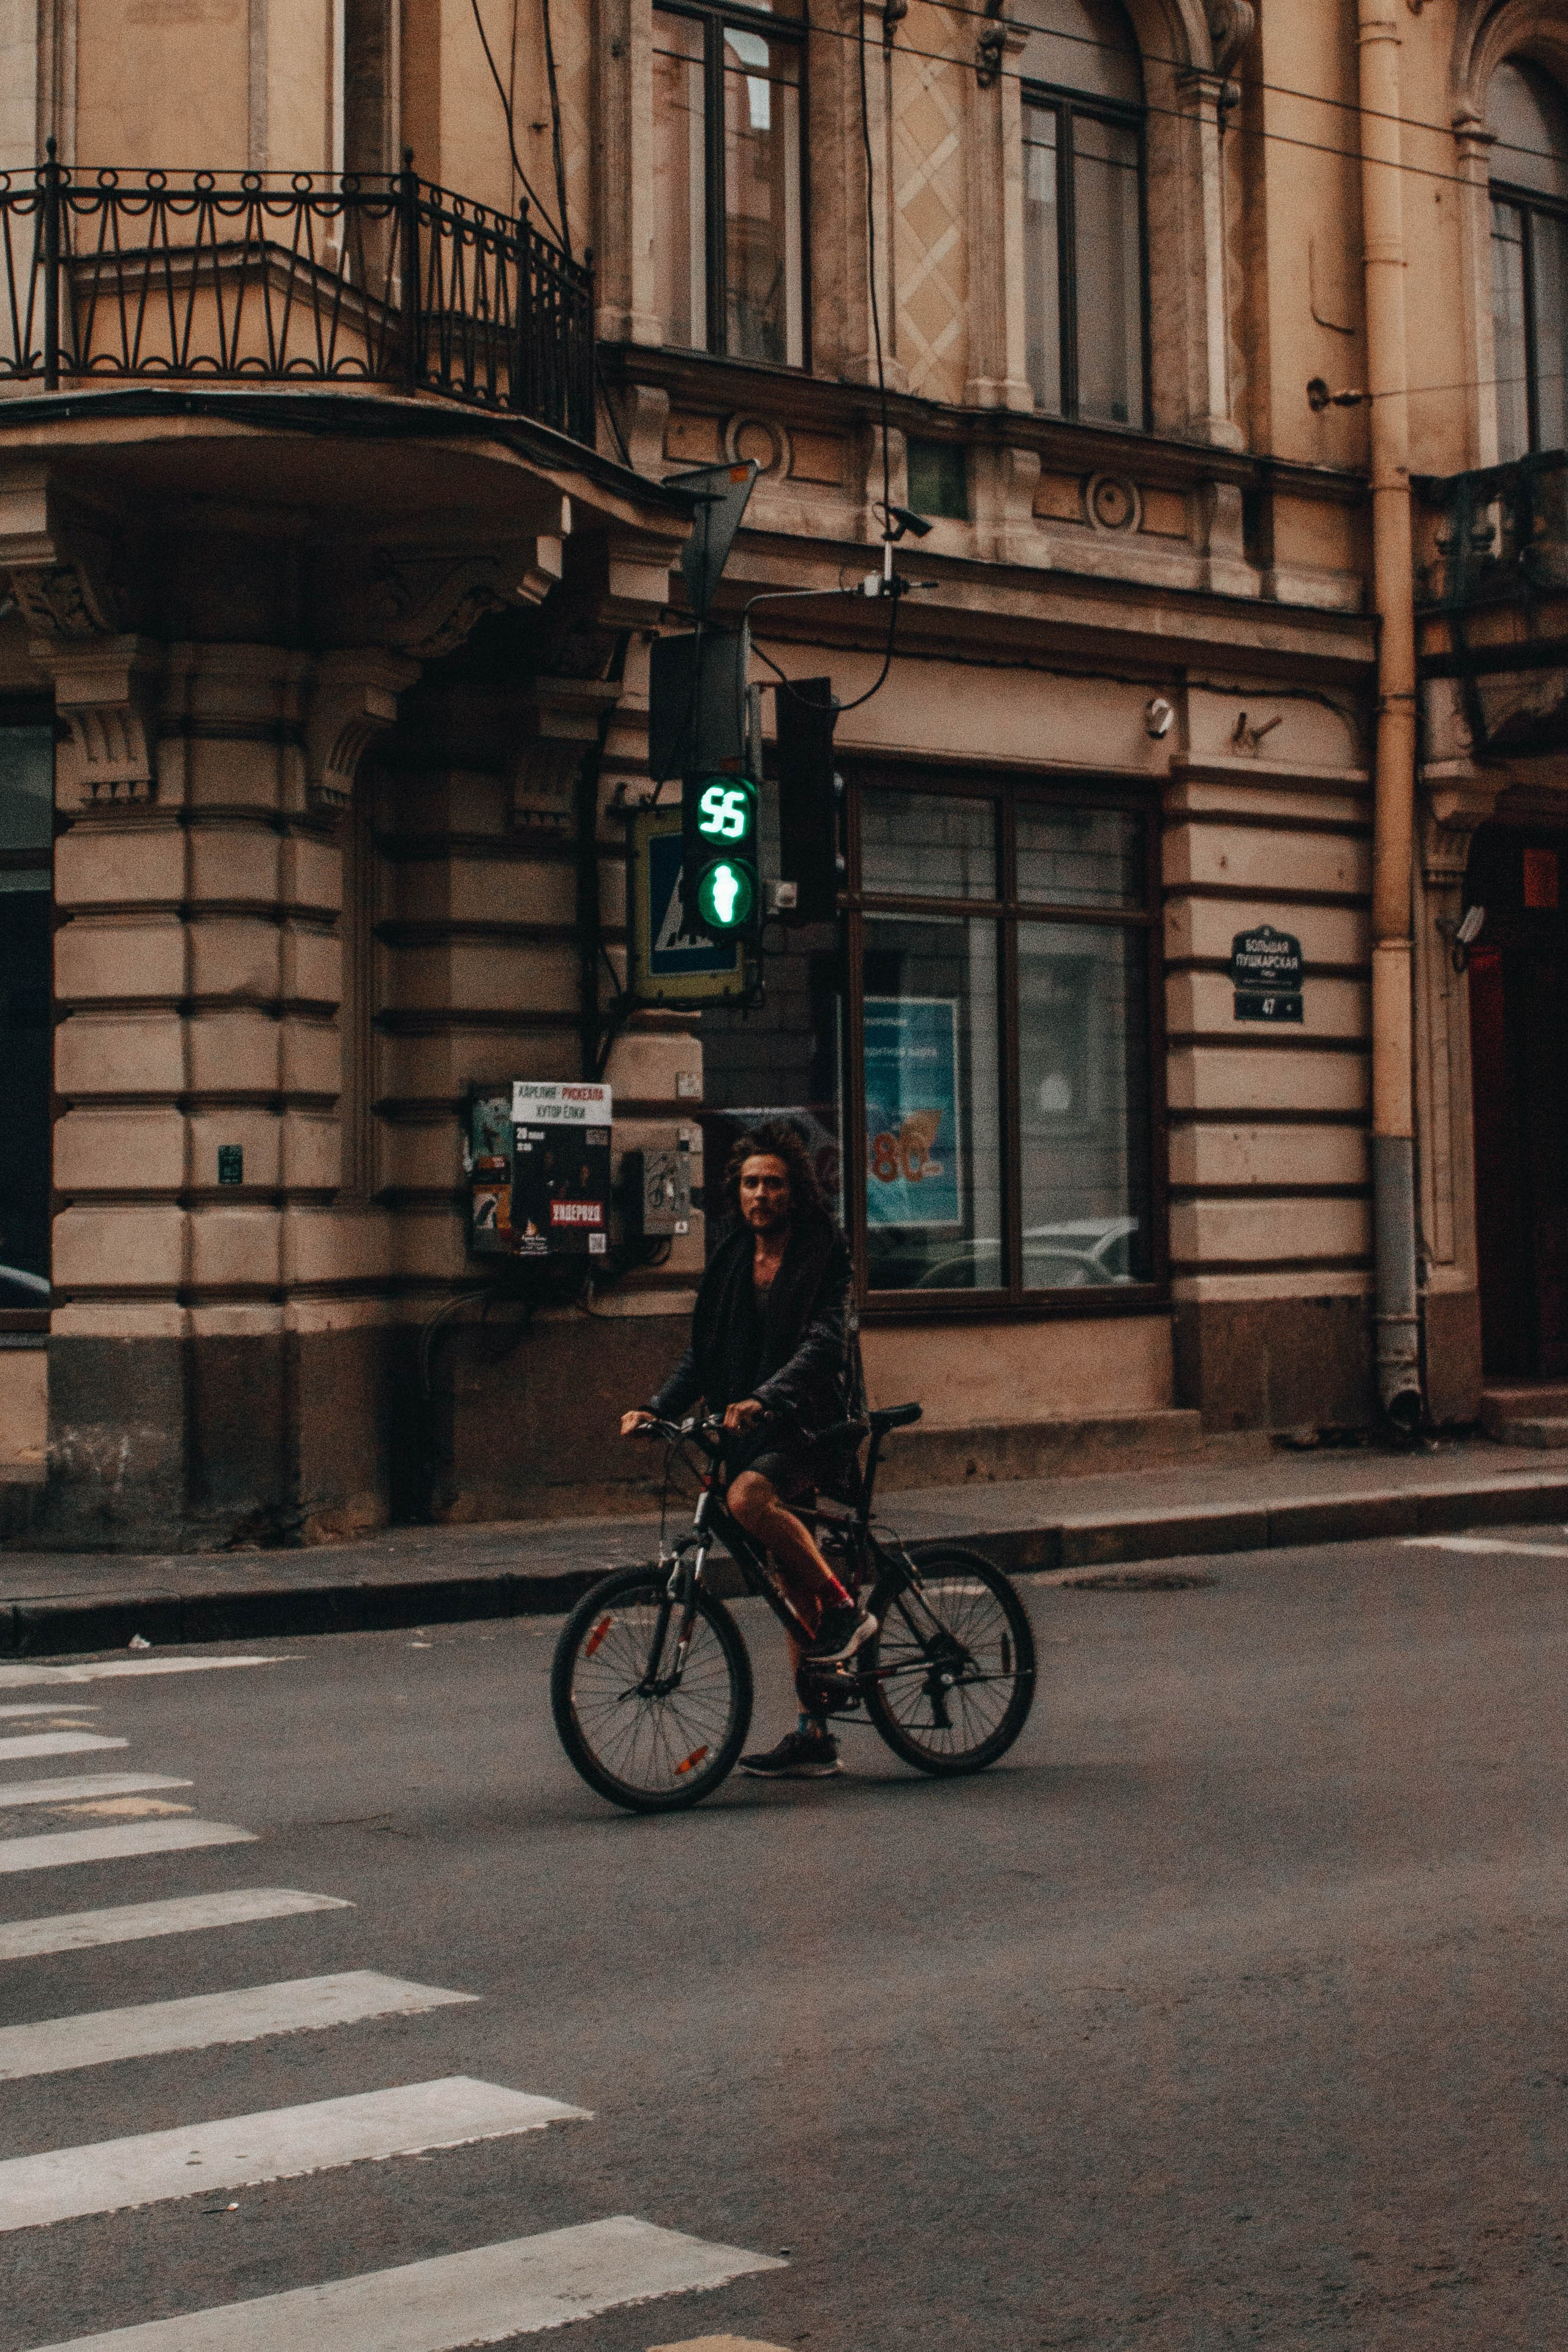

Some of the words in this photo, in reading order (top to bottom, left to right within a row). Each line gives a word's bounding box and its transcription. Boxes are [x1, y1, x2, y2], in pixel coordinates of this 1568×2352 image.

[1245, 938, 1289, 953] БОЛЬШАЯ
[1236, 953, 1298, 970] ПУШКАРСКАЯ
[1262, 998, 1275, 1015] 47
[536, 1105, 562, 1118] ХУТОР
